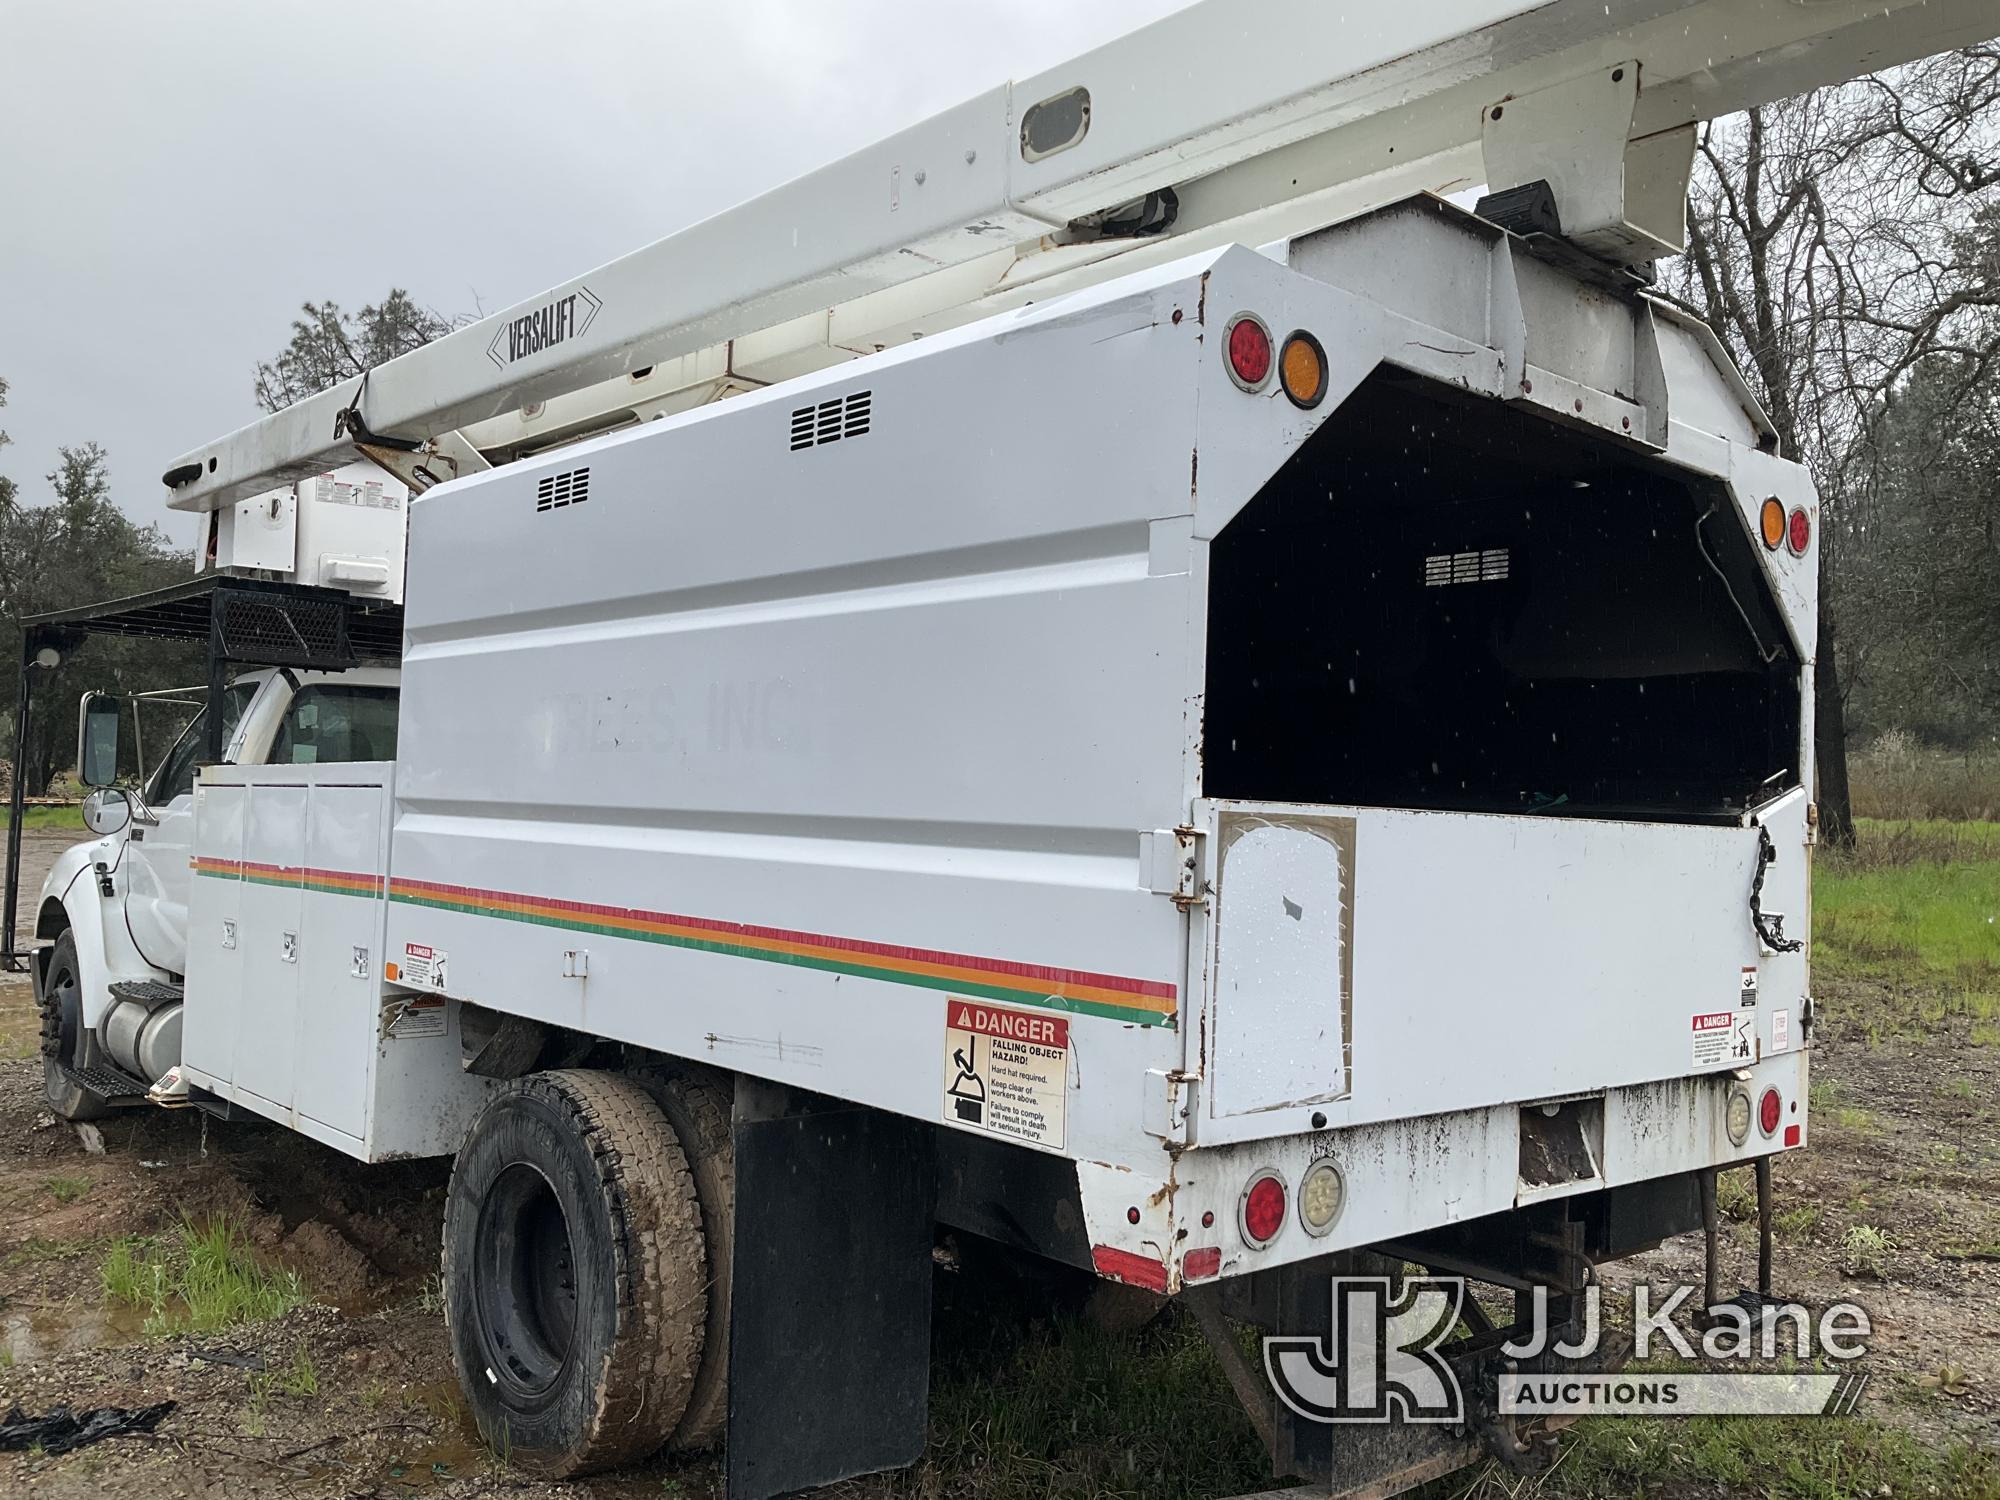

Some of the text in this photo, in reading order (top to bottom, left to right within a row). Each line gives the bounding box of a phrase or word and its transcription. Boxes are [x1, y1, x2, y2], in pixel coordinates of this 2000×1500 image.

[508, 294, 576, 363] VERSALIFT
[413, 946, 430, 957] DANGER
[976, 1010, 1055, 1042] DANGER
[1704, 1014, 1729, 1028] DANGER
[992, 1039, 1063, 1060] FALLING OBJECT
[992, 1051, 1028, 1065] HAZARD!
[992, 1066, 1048, 1084] Hard hat required.
[991, 1079, 1033, 1094] Keep clear of
[991, 1089, 1038, 1105] workers above.
[991, 1101, 1044, 1121] Failure to comply
[990, 1112, 1046, 1130] will result in death
[998, 1122, 1021, 1134] serious
[1022, 1127, 1042, 1140] injury.
